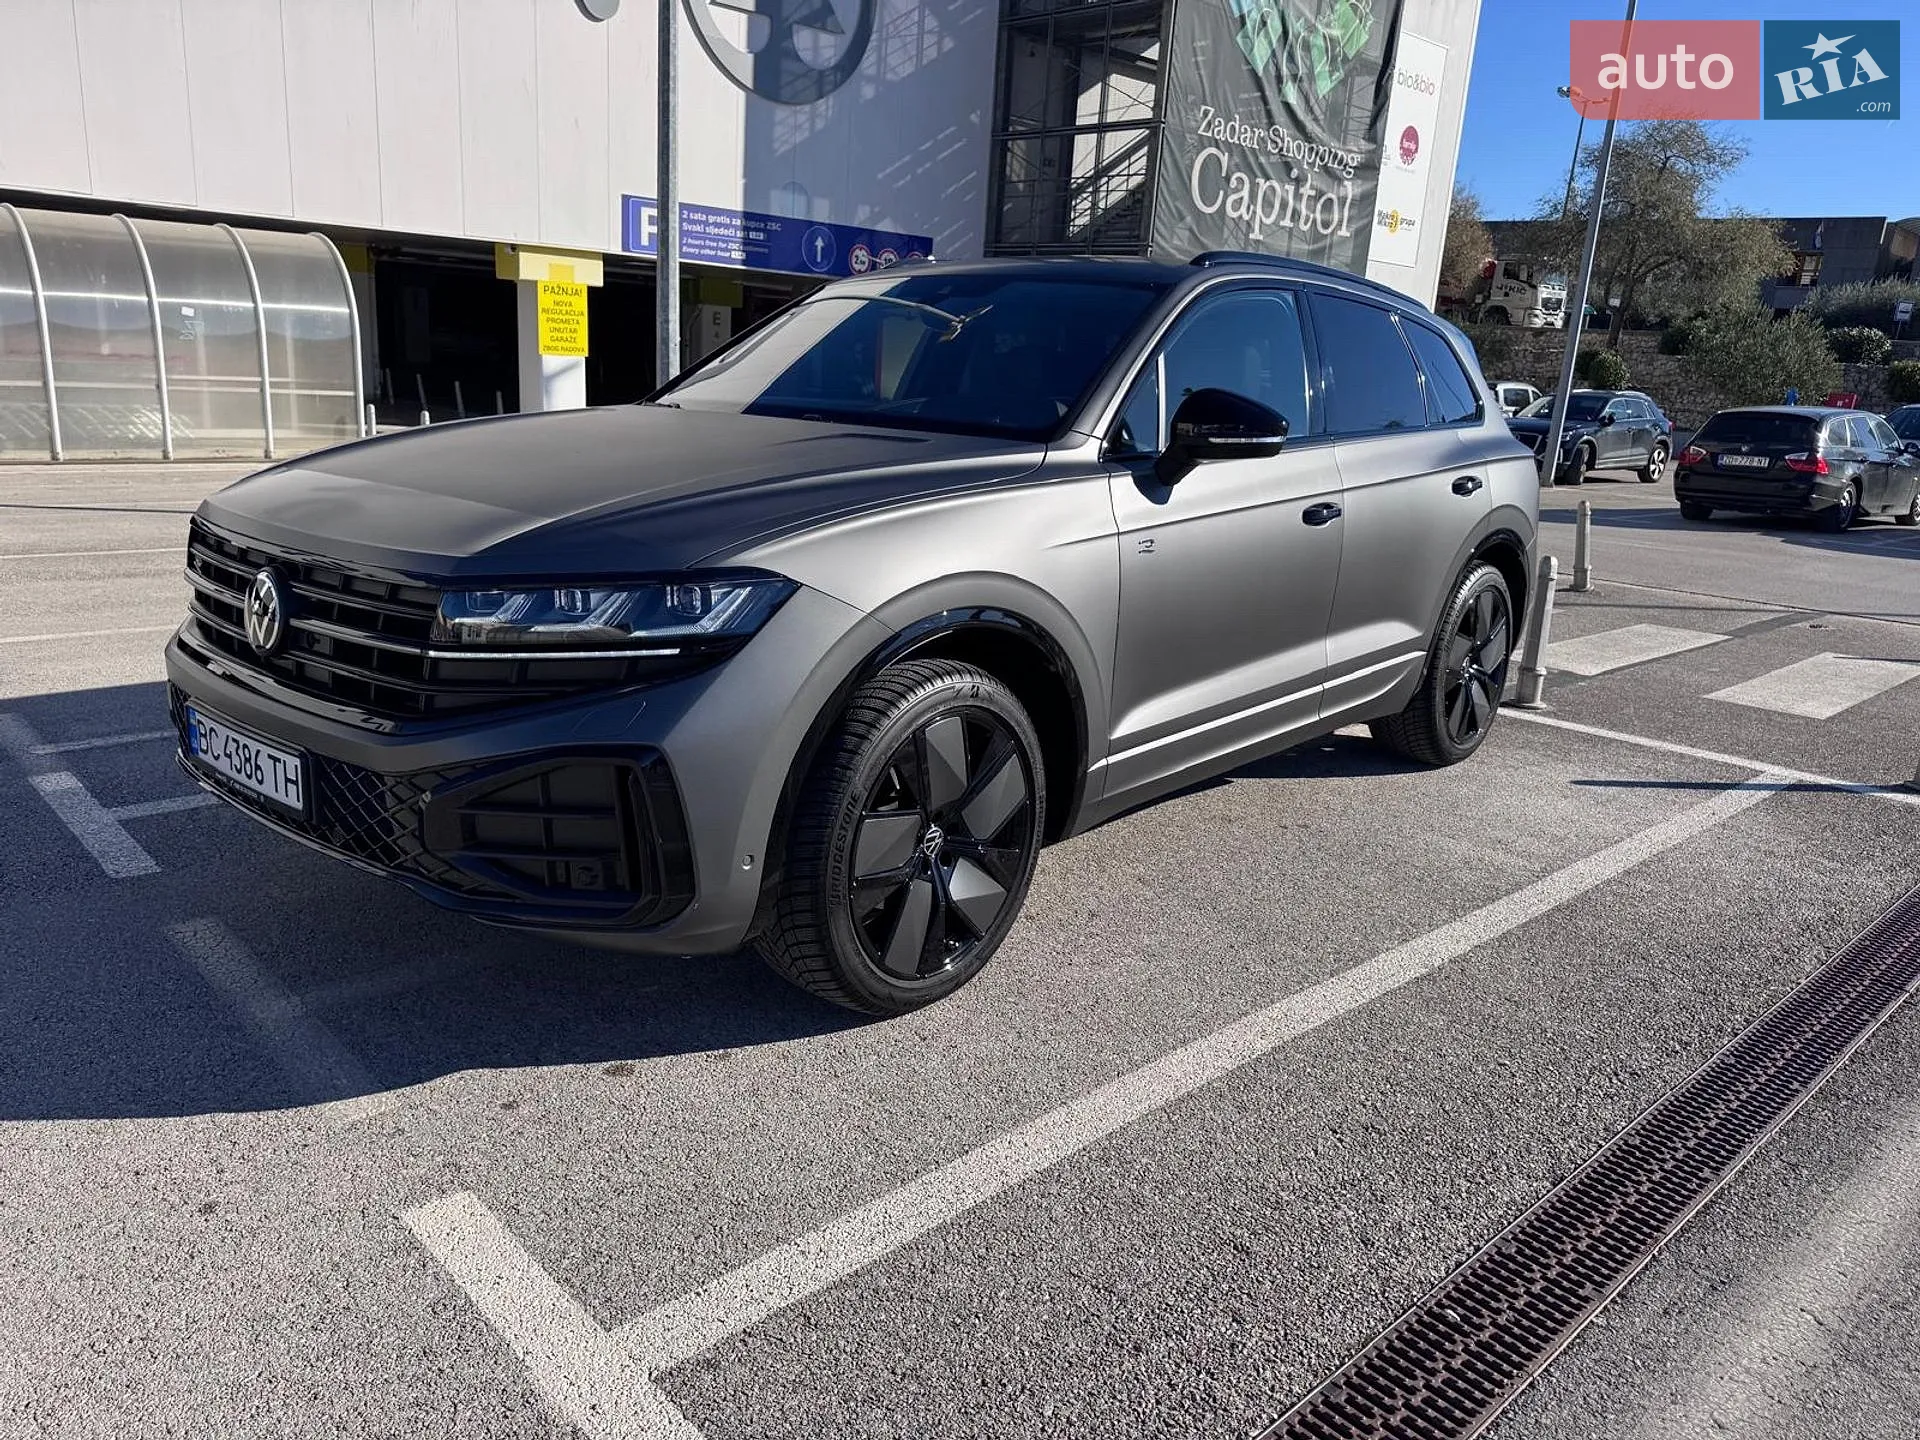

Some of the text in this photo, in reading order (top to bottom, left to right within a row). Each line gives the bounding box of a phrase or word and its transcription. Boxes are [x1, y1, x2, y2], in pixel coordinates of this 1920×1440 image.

[1397, 67, 1435, 95] bio&bio
[1198, 105, 1361, 178] Zadar Shopping
[1190, 147, 1352, 240] Capitol
[682, 210, 688, 218] 2
[690, 212, 706, 220] sata
[708, 214, 730, 224] gratis
[682, 222, 704, 233] Svaki
[543, 283, 582, 297] PAŽNJA!
[713, 311, 721, 326] E
[196, 718, 220, 761] BC
[224, 734, 264, 786] 4386
[267, 753, 300, 803] TH
